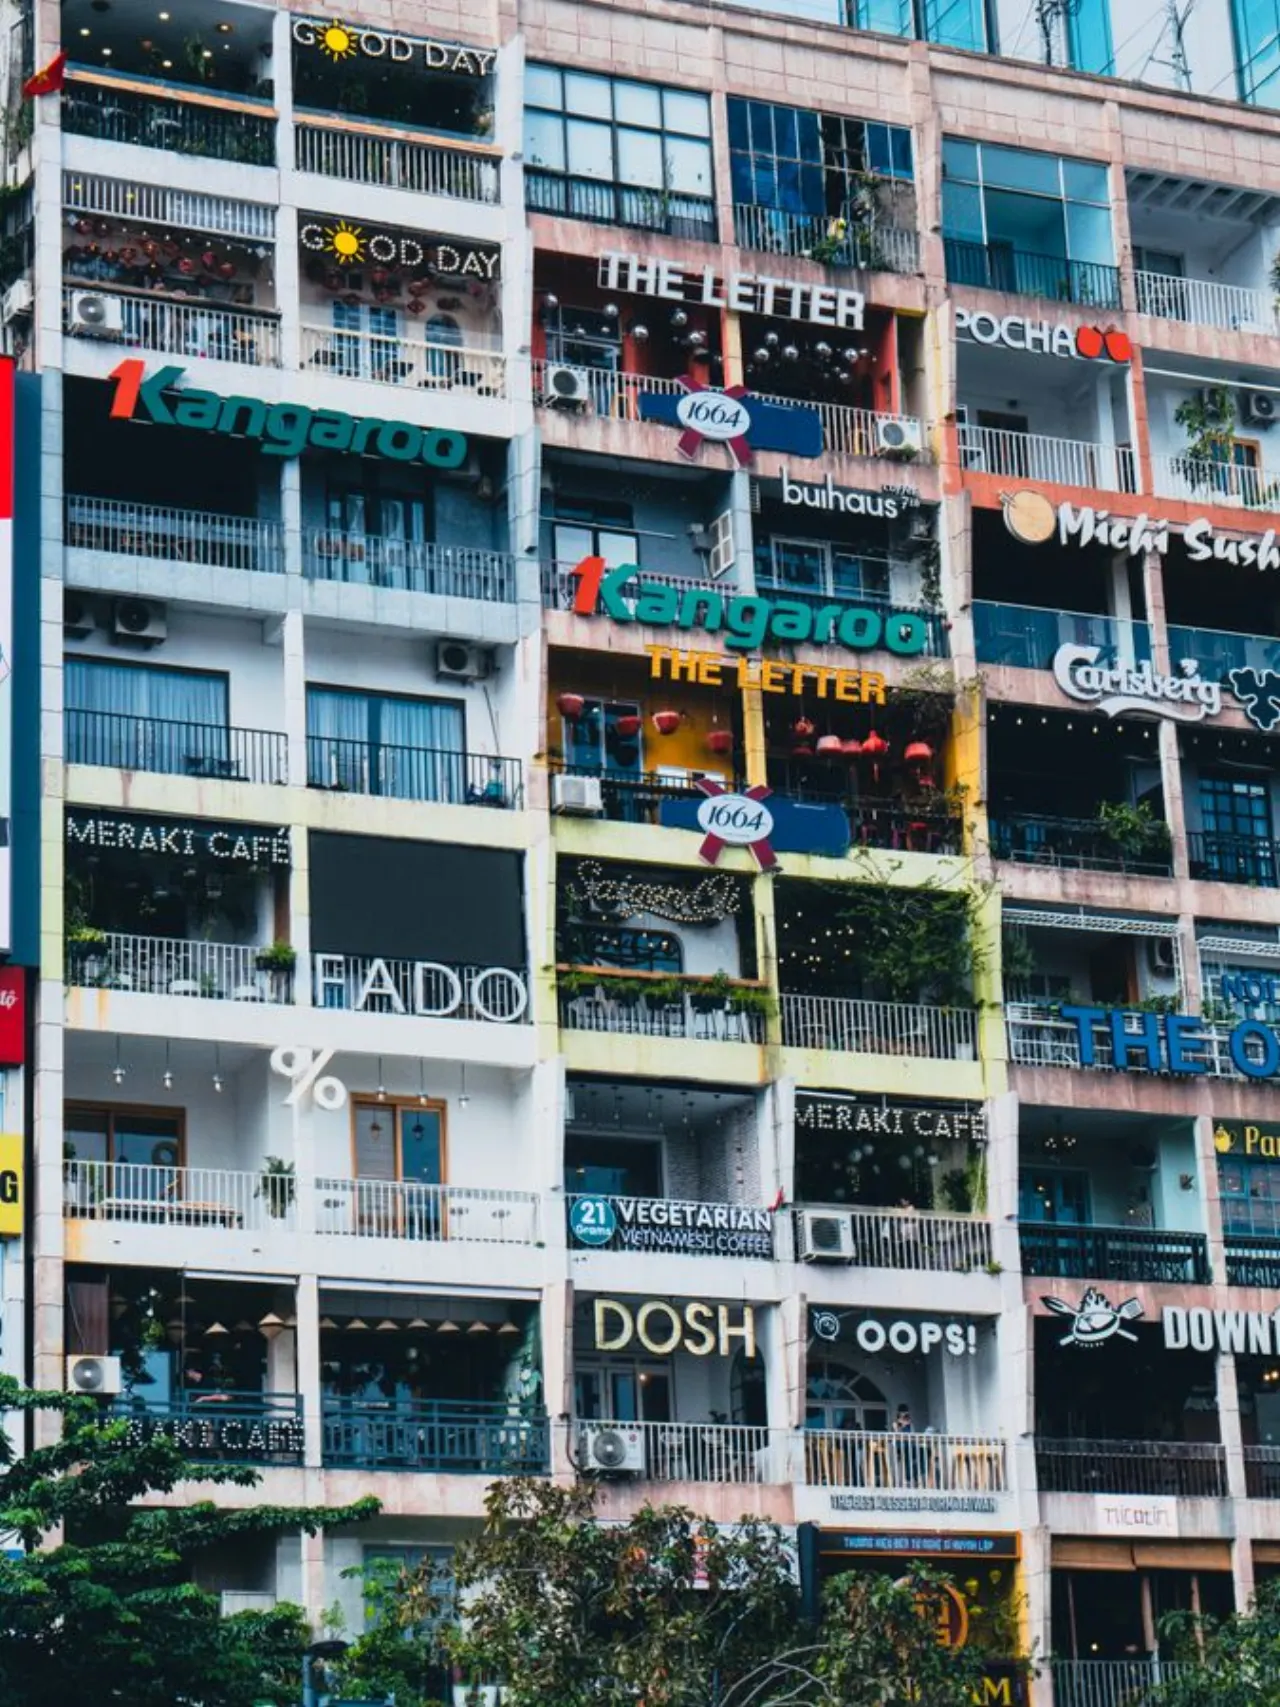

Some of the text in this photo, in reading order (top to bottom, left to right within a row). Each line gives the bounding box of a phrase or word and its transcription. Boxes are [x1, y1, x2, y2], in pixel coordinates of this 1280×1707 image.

[426, 42, 495, 76] DAY
[438, 246, 498, 278] DAY
[599, 251, 865, 331] THE LETTER
[687, 400, 742, 428] 1664
[1058, 502, 1168, 556] Michi
[645, 644, 887, 705] THE LETTER
[1053, 642, 1221, 716] Carlsberg
[708, 804, 765, 832] 1664
[67, 817, 289, 864] MERAKI CAFÉ
[314, 952, 528, 1023] FADO
[1059, 1004, 1207, 1074] THE
[795, 1102, 904, 1135] MERAKI
[580, 1201, 605, 1225] 21
[618, 1201, 772, 1231] VEGETARIAN
[716, 1234, 771, 1254] COFFEE
[595, 1299, 755, 1357] DOSH
[856, 1320, 976, 1355] OOPS!
